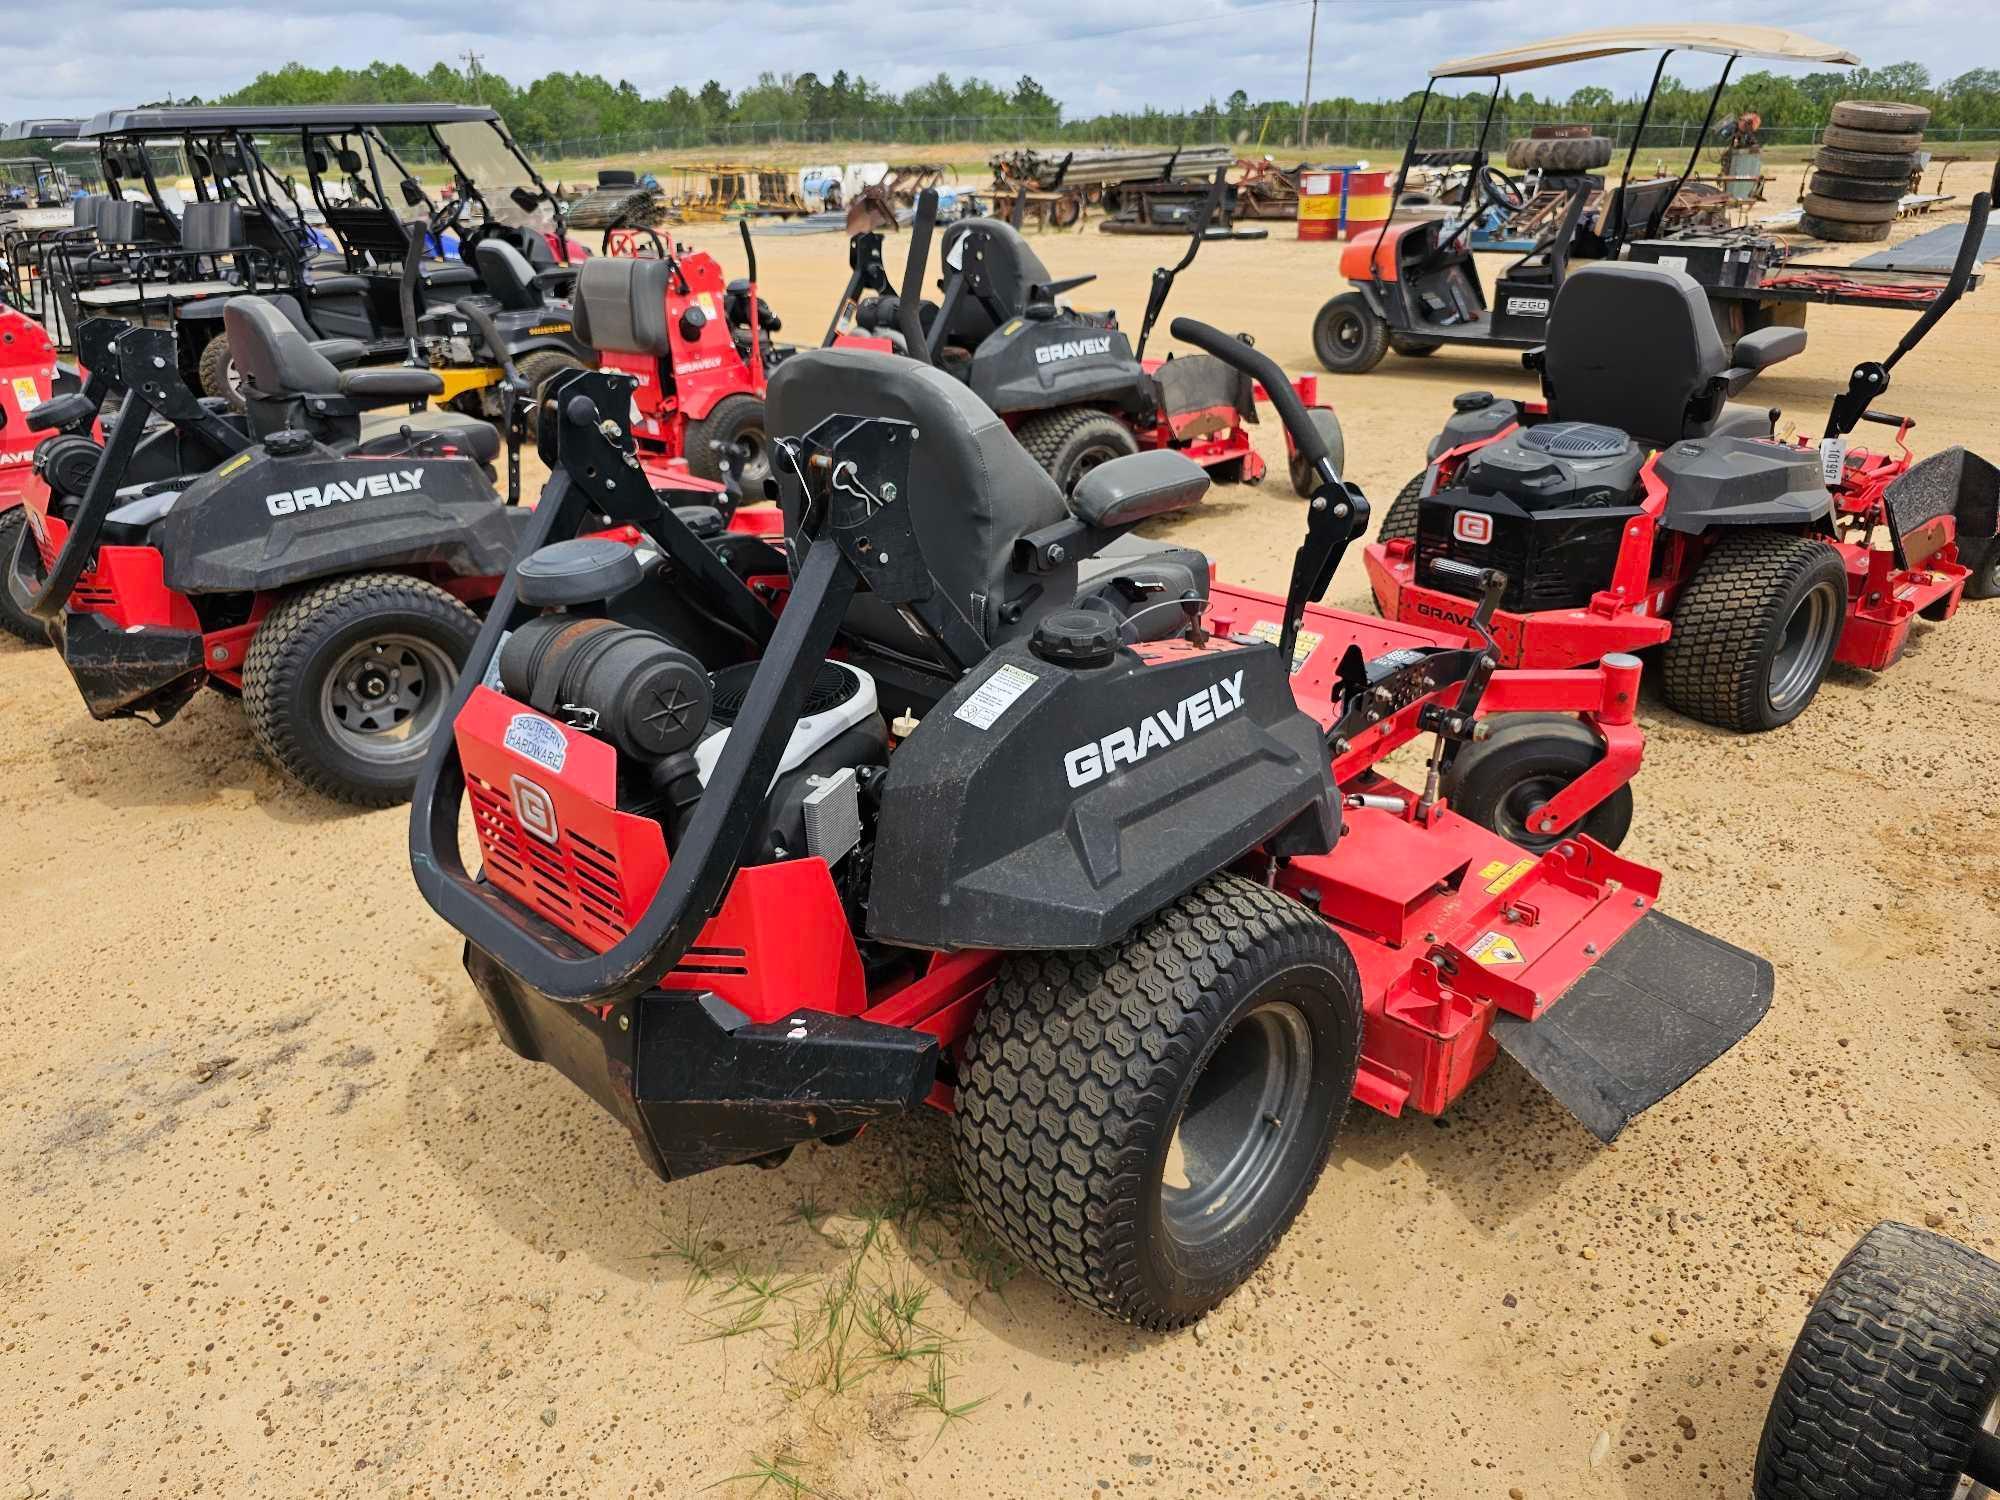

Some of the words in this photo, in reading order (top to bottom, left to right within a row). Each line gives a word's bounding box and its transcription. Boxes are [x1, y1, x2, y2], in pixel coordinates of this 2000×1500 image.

[1511, 300, 1546, 311] EZGO
[1035, 335, 1111, 364] GRAVELY
[0, 449, 35, 465] AVE
[265, 467, 425, 516] GRAVELY
[1417, 603, 1500, 636] GRAVEY
[516, 718, 563, 748] SOUTHERN
[1063, 669, 1245, 788] GRAVELY
[506, 733, 562, 769] HARDWARE
